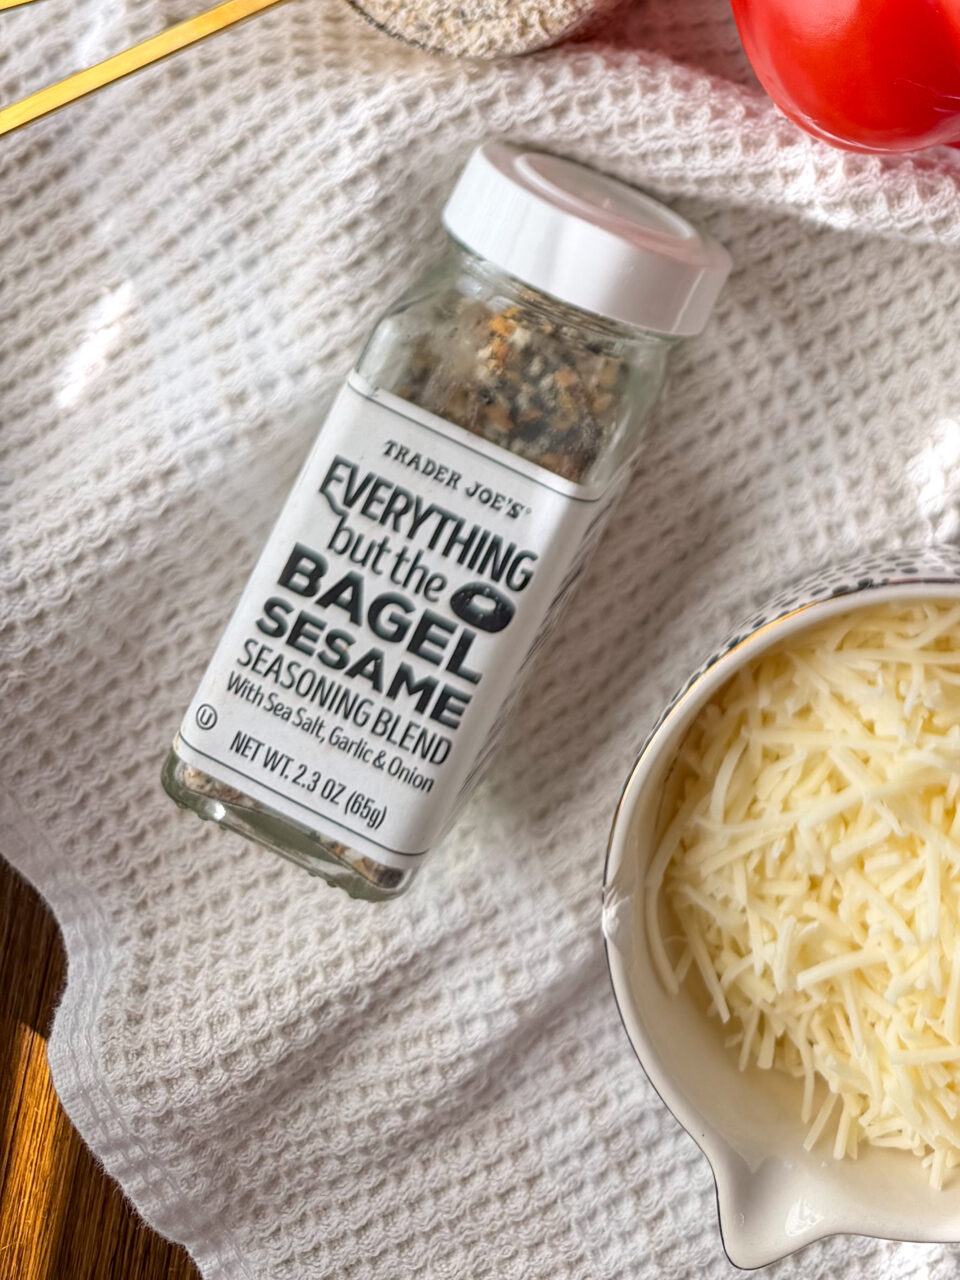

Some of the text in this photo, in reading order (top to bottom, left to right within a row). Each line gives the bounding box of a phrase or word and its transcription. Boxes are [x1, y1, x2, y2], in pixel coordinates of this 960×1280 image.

[318, 454, 539, 592] EVERYTHING
[383, 440, 526, 520] TRADER JOE'S
[277, 542, 483, 686] BAGEL
[326, 517, 448, 603] but the
[237, 638, 453, 766] SEASONING BLEND
[255, 596, 472, 730] SESAME
[226, 670, 435, 794] With Sea Salt, Garlic & Onion
[229, 730, 388, 830] NET WT. 2.3 OZ (65g)
